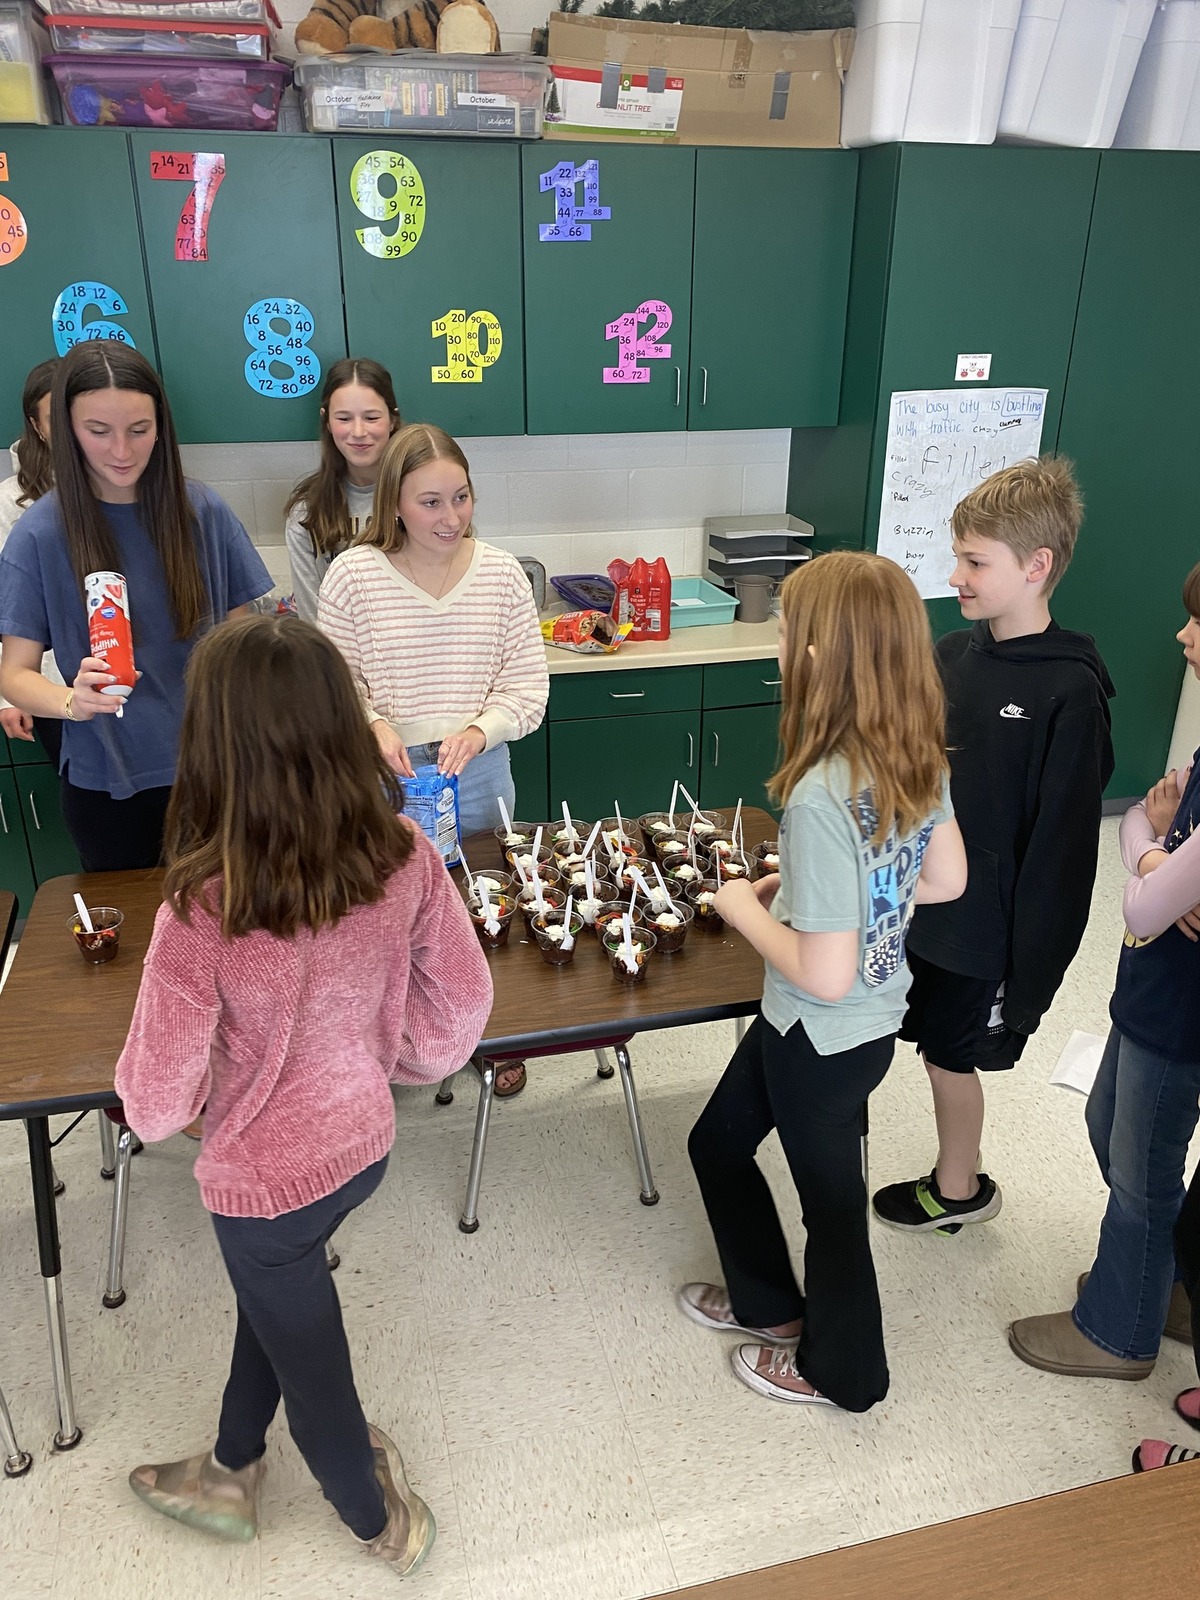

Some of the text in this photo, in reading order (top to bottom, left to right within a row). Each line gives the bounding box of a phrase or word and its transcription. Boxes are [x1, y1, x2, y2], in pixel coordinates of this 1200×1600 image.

[470, 95, 496, 104] October
[161, 155, 174, 167] 14
[366, 156, 381, 168] 45
[389, 157, 405, 169] 54
[152, 163, 159, 174] 7
[177, 163, 190, 175] 21
[559, 168, 571, 178] 22
[400, 176, 416, 187] 63
[544, 176, 552, 186] 11
[560, 187, 573, 197] 33
[350, 149, 426, 259] 9
[409, 195, 423, 207] 72
[539, 159, 611, 241] 11
[150, 151, 226, 261] 7
[389, 201, 397, 211] 9
[558, 207, 571, 217] 44
[181, 214, 196, 225] 63
[404, 213, 417, 225] 81
[8, 225, 24, 238] 45
[549, 226, 560, 235] 55
[569, 227, 582, 236] 66
[401, 231, 417, 242] 90
[178, 239, 191, 249] 77
[191, 248, 207, 259] 84
[386, 245, 401, 256] 99
[72, 286, 86, 298] 18
[93, 288, 107, 299] 12
[60, 302, 77, 314] 24
[112, 300, 121, 311] 6
[264, 302, 280, 314] 24
[285, 303, 300, 315] 32
[638, 306, 650, 314] 144
[247, 313, 260, 325] 16
[451, 313, 465, 323] 20
[471, 316, 482, 324] 90
[623, 317, 635, 326] 24
[57, 320, 75, 332] 30
[295, 321, 312, 332] 40
[435, 322, 446, 331] 10
[487, 322, 500, 330] 100
[610, 325, 619, 333] 12
[86, 329, 102, 340] 72
[108, 330, 125, 341] 66
[258, 330, 266, 341] 8
[447, 335, 461, 344] 30
[620, 336, 631, 344] 36
[286, 337, 303, 348] 48
[432, 309, 502, 383] 10
[489, 337, 501, 345] 110
[603, 300, 672, 383] 12
[244, 297, 320, 399] 8
[267, 345, 283, 356] 56
[451, 353, 465, 362] 40
[469, 350, 480, 358] 70
[624, 352, 635, 361] 48
[250, 360, 266, 371] 64
[295, 355, 311, 366] 96
[299, 374, 315, 385] 88
[437, 370, 450, 379] 50
[461, 370, 475, 379] 60
[612, 370, 625, 378] 60
[632, 371, 642, 379] 72
[259, 379, 273, 390] 72
[281, 383, 298, 394] 80
[896, 395, 1042, 422] The busy city is bustling
[896, 423, 917, 437] with
[1005, 703, 1025, 716] NIKE
